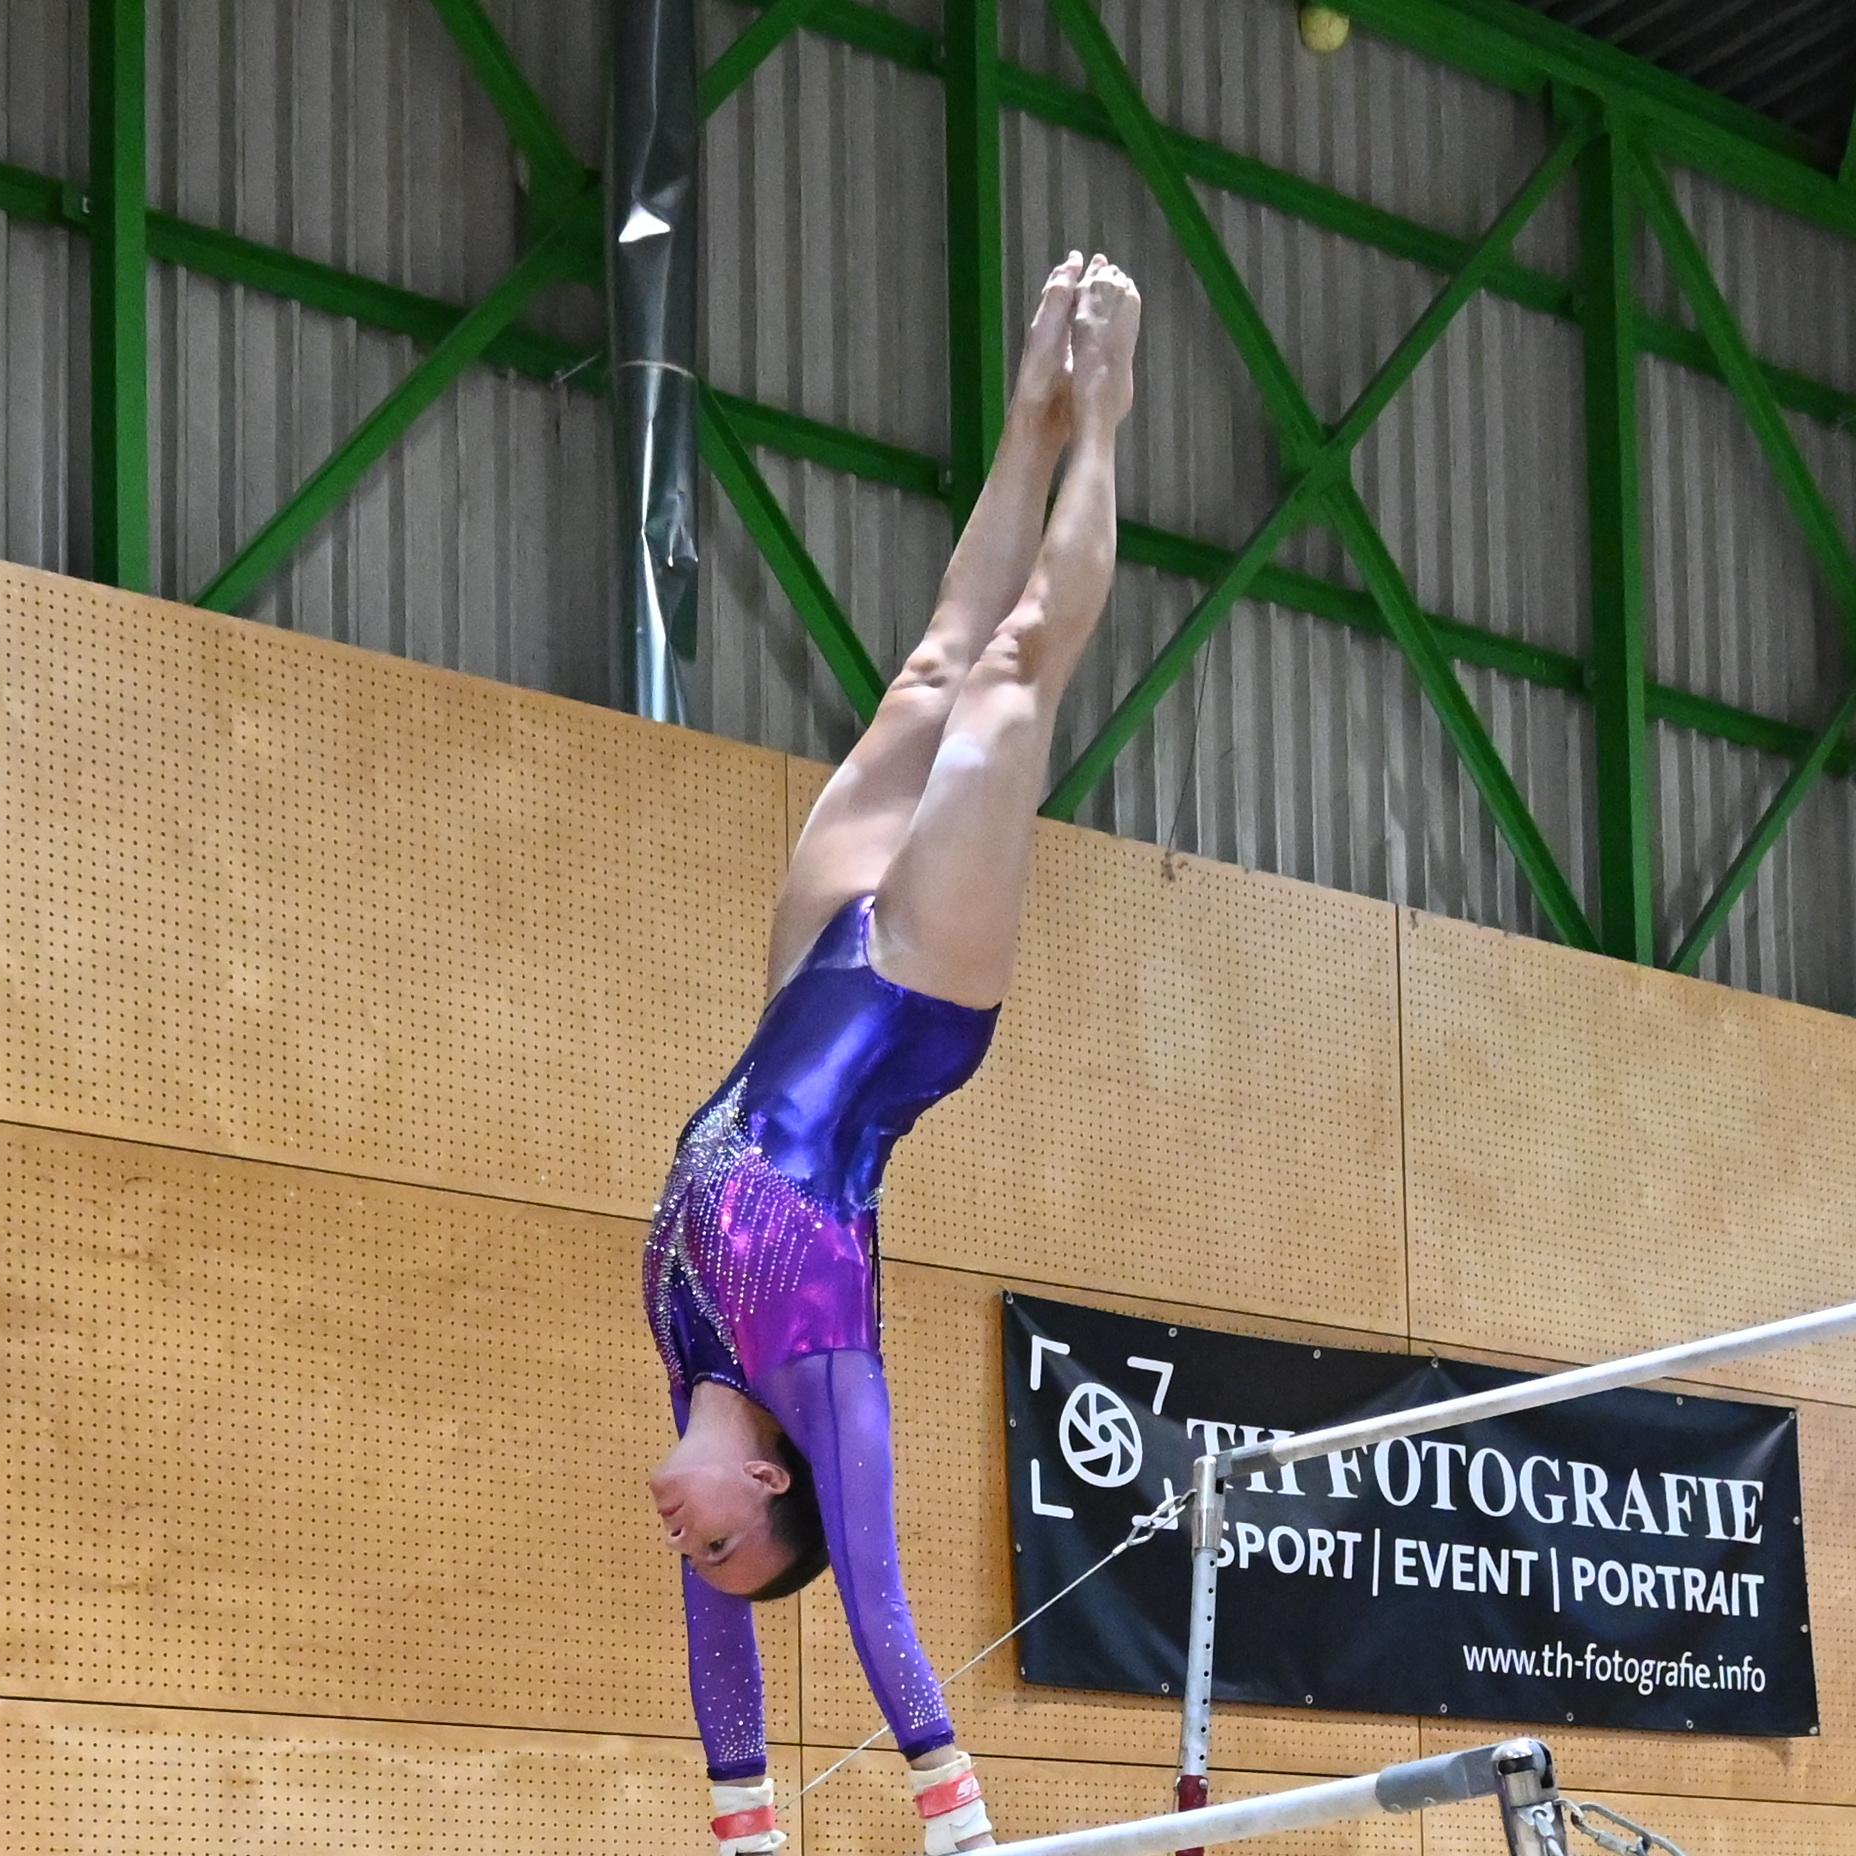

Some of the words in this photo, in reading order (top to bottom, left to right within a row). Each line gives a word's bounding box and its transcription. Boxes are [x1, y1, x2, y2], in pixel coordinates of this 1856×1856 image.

[1327, 1435, 1765, 1545] FOTOGRAFIE
[1216, 1520, 1363, 1580] SPORT
[1393, 1537, 1540, 1598] EVENT
[1571, 1556, 1766, 1618] PORTRAIT
[1462, 1639, 1767, 1697] www.th-fotografie.info
